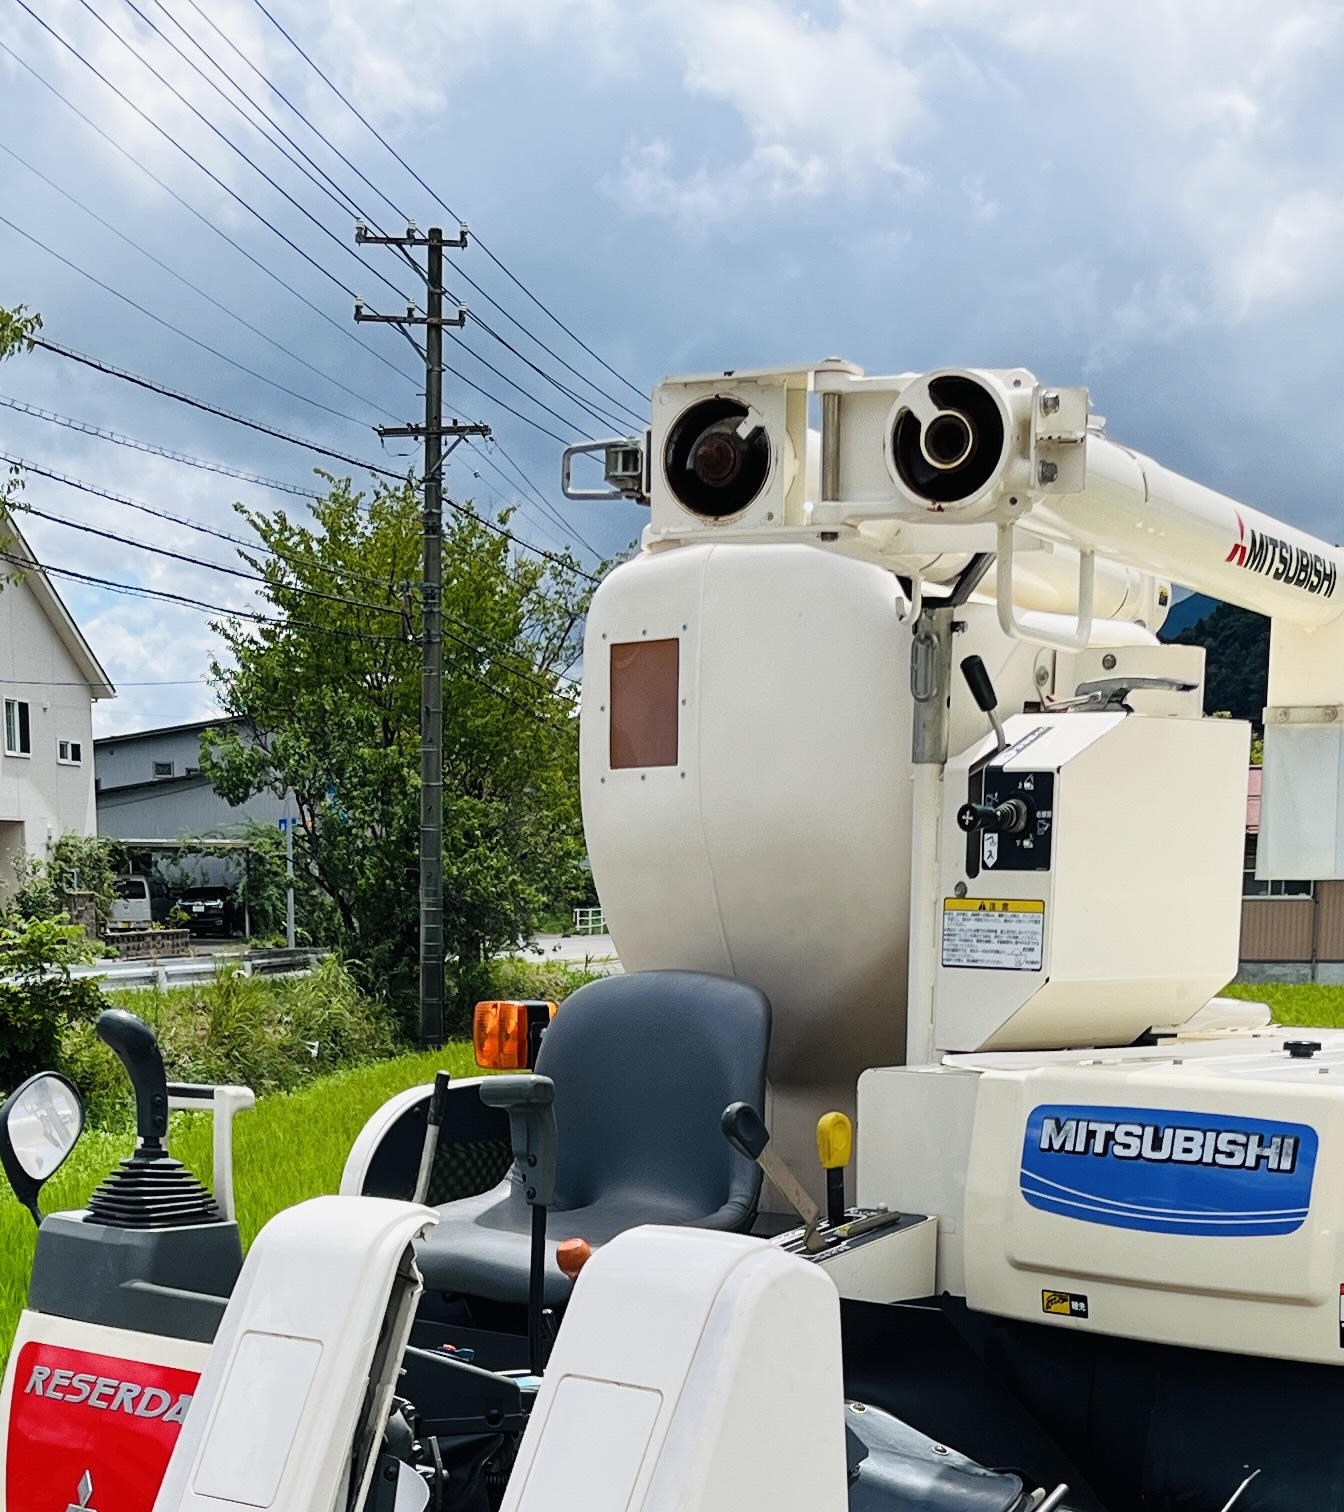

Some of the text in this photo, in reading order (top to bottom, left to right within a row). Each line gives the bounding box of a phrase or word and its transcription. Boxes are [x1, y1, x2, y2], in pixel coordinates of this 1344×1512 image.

[1243, 529, 1337, 598] MITSUBISHI
[1039, 1116, 1298, 1174] MITSUBISHI
[23, 1364, 194, 1425] RESERDA
